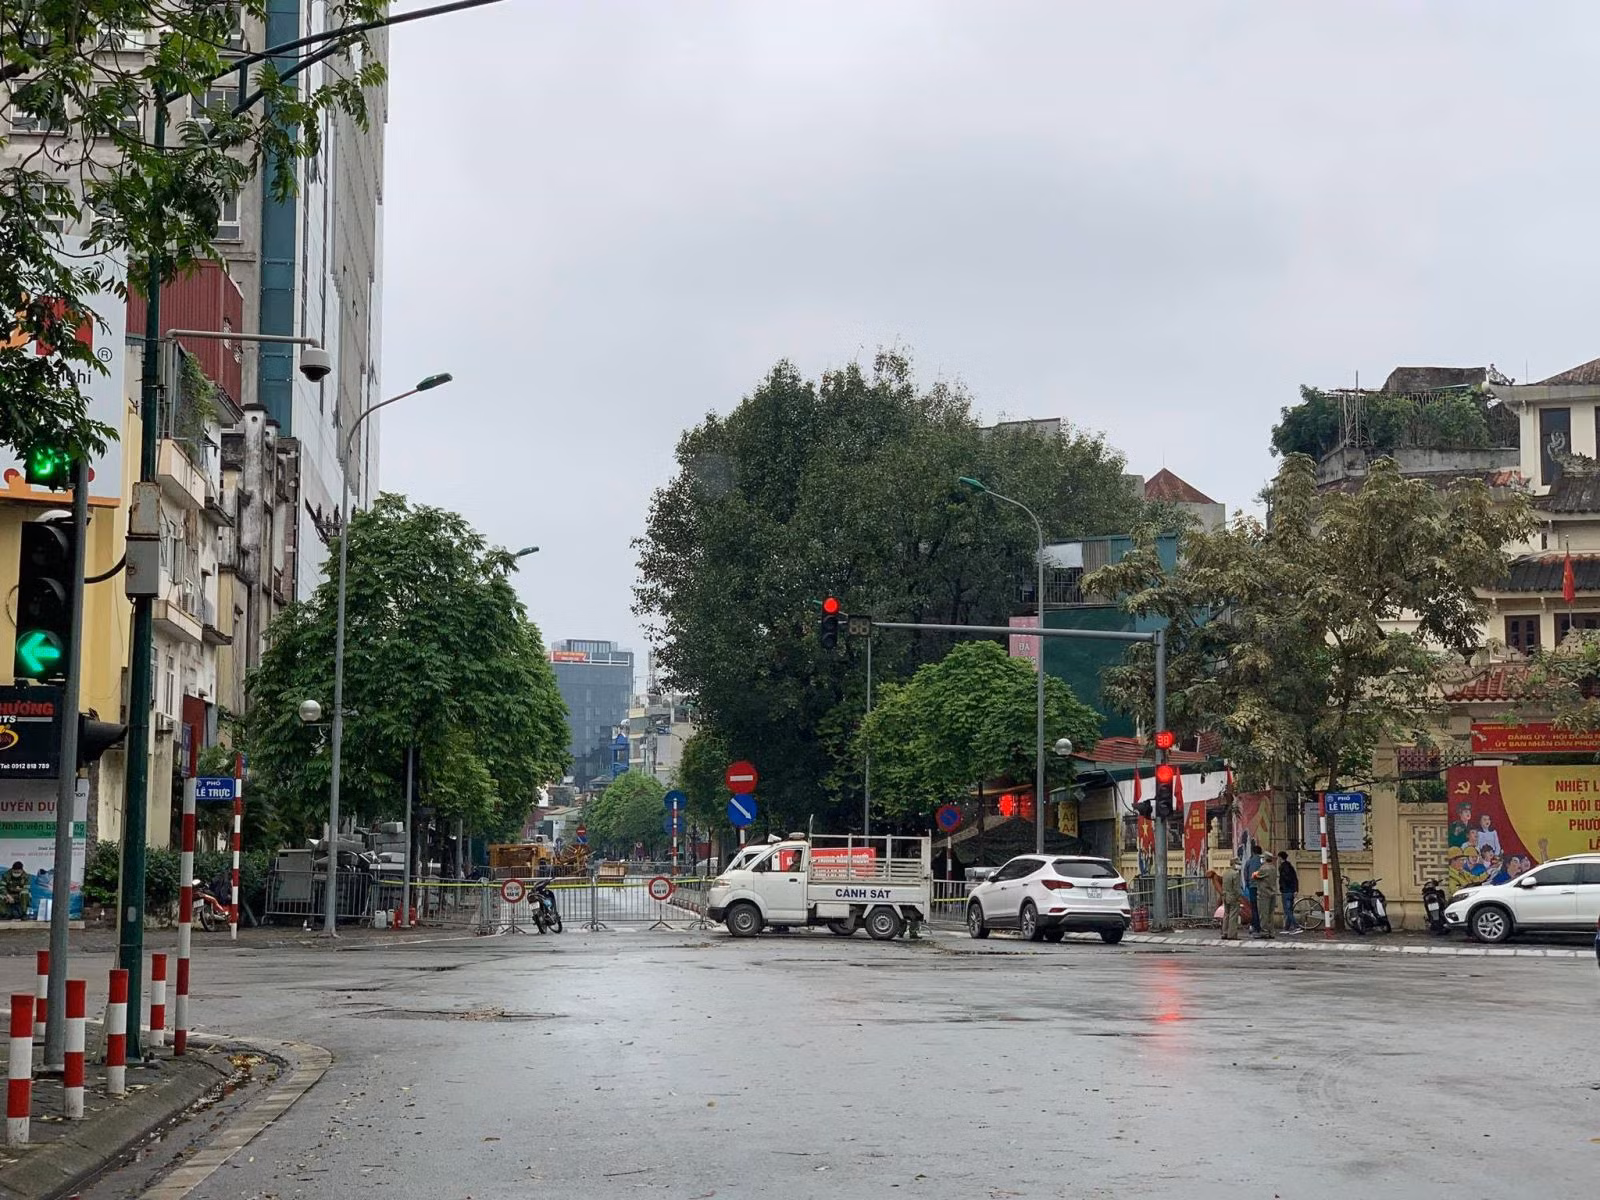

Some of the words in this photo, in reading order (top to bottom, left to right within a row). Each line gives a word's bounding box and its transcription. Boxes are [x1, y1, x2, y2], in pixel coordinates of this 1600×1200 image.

[196, 786, 206, 797] LÊ
[208, 787, 230, 798] TRỰC
[1555, 778, 1589, 794] NHIỆT
[1329, 801, 1338, 811] LÊ
[1340, 802, 1360, 812] TRỰC
[1548, 799, 1568, 814] ĐẠI
[1571, 797, 1591, 814] HỘI
[835, 886, 868, 899] CẢNH
[870, 889, 892, 899] SÁT
